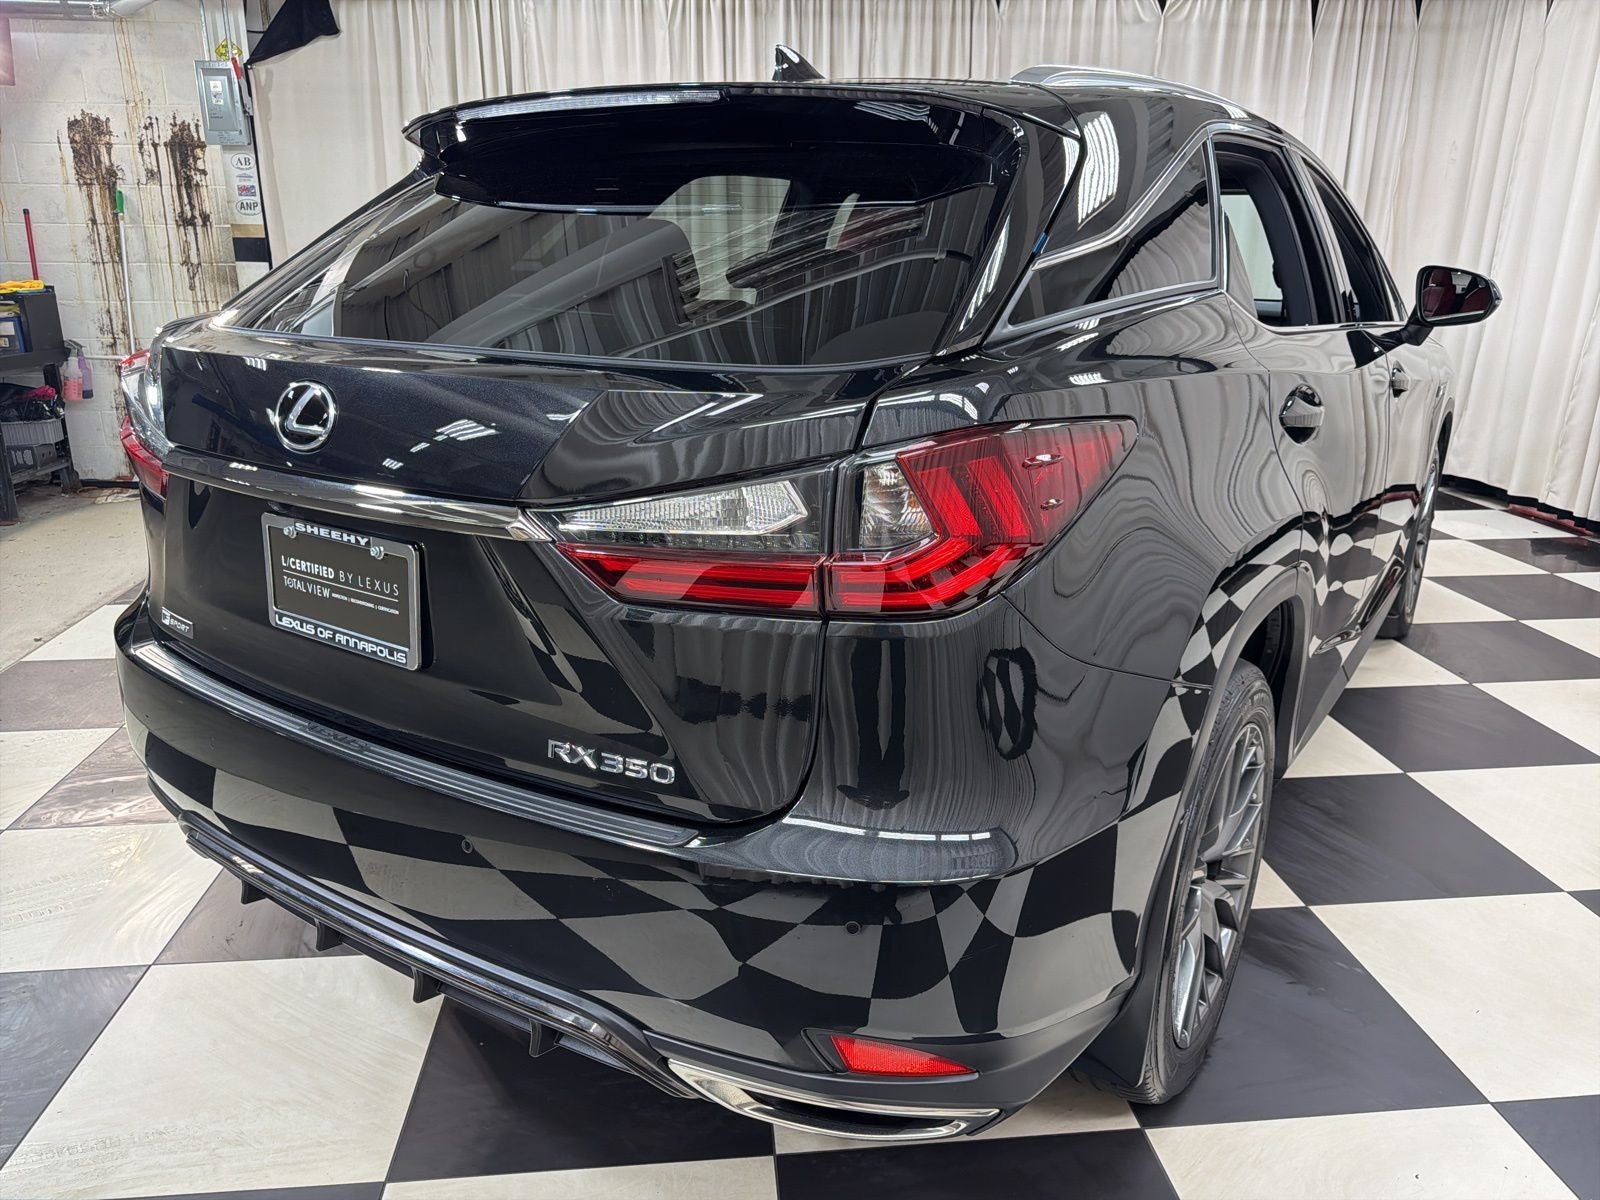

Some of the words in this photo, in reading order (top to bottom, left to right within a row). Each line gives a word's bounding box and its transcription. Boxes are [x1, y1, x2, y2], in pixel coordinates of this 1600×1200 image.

[235, 157, 251, 166] AB
[240, 201, 258, 210] ANP
[295, 522, 369, 546] SHEEHY
[281, 555, 335, 579] L/CERTIFIED
[339, 570, 353, 584] BY
[358, 575, 399, 596] LEXUS
[169, 618, 190, 633] SPORT
[275, 614, 316, 635] LEXUS
[316, 627, 334, 639] OF
[335, 633, 406, 664] ANNAPOLIS
[547, 739, 598, 769] RX
[600, 752, 675, 784] 350
